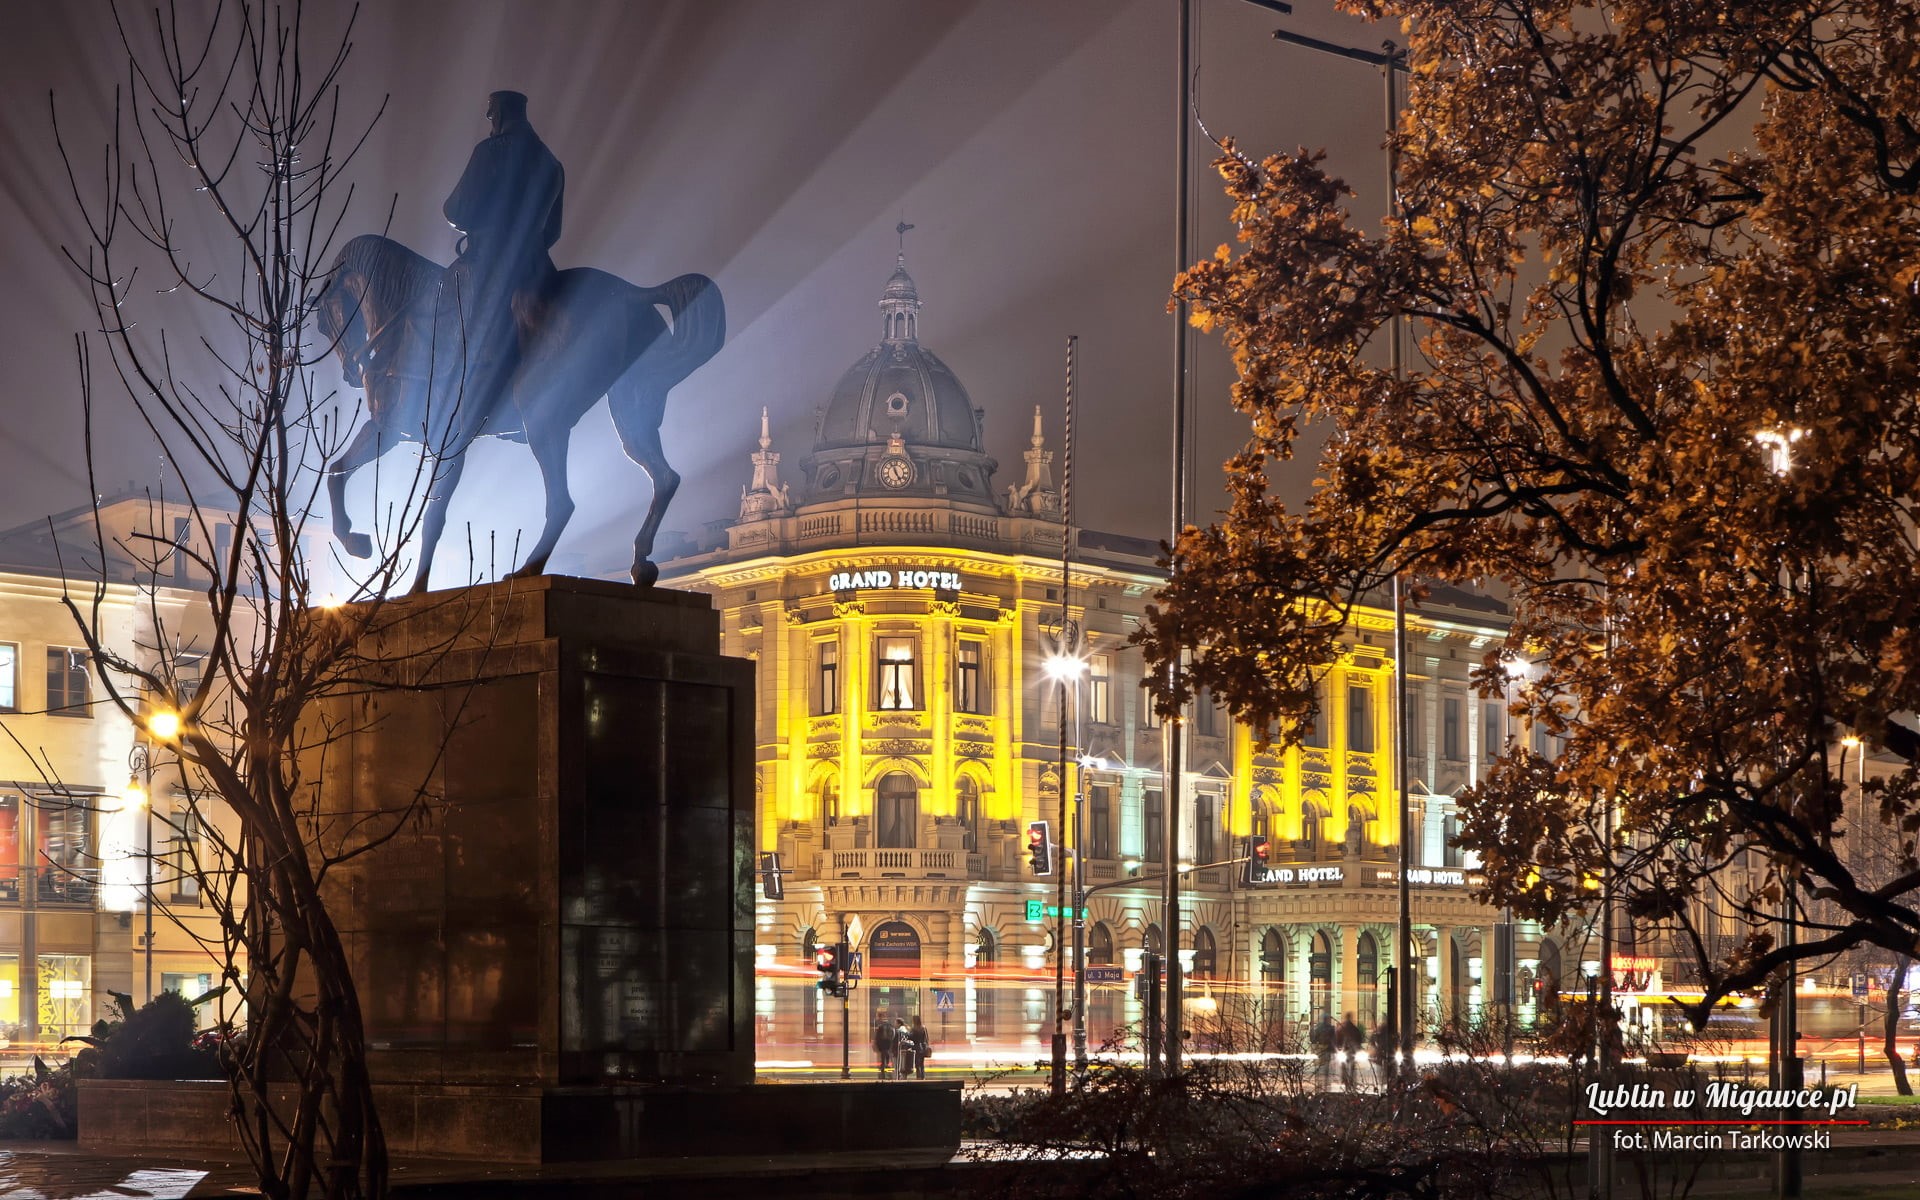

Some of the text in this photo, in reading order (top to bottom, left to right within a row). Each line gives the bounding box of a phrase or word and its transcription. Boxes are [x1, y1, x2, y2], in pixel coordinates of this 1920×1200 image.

[829, 570, 962, 591] GRAND HOTEL
[1298, 867, 1343, 881] HOTEL
[1433, 870, 1465, 885] HOTEL
[1104, 971, 1120, 980] Maja
